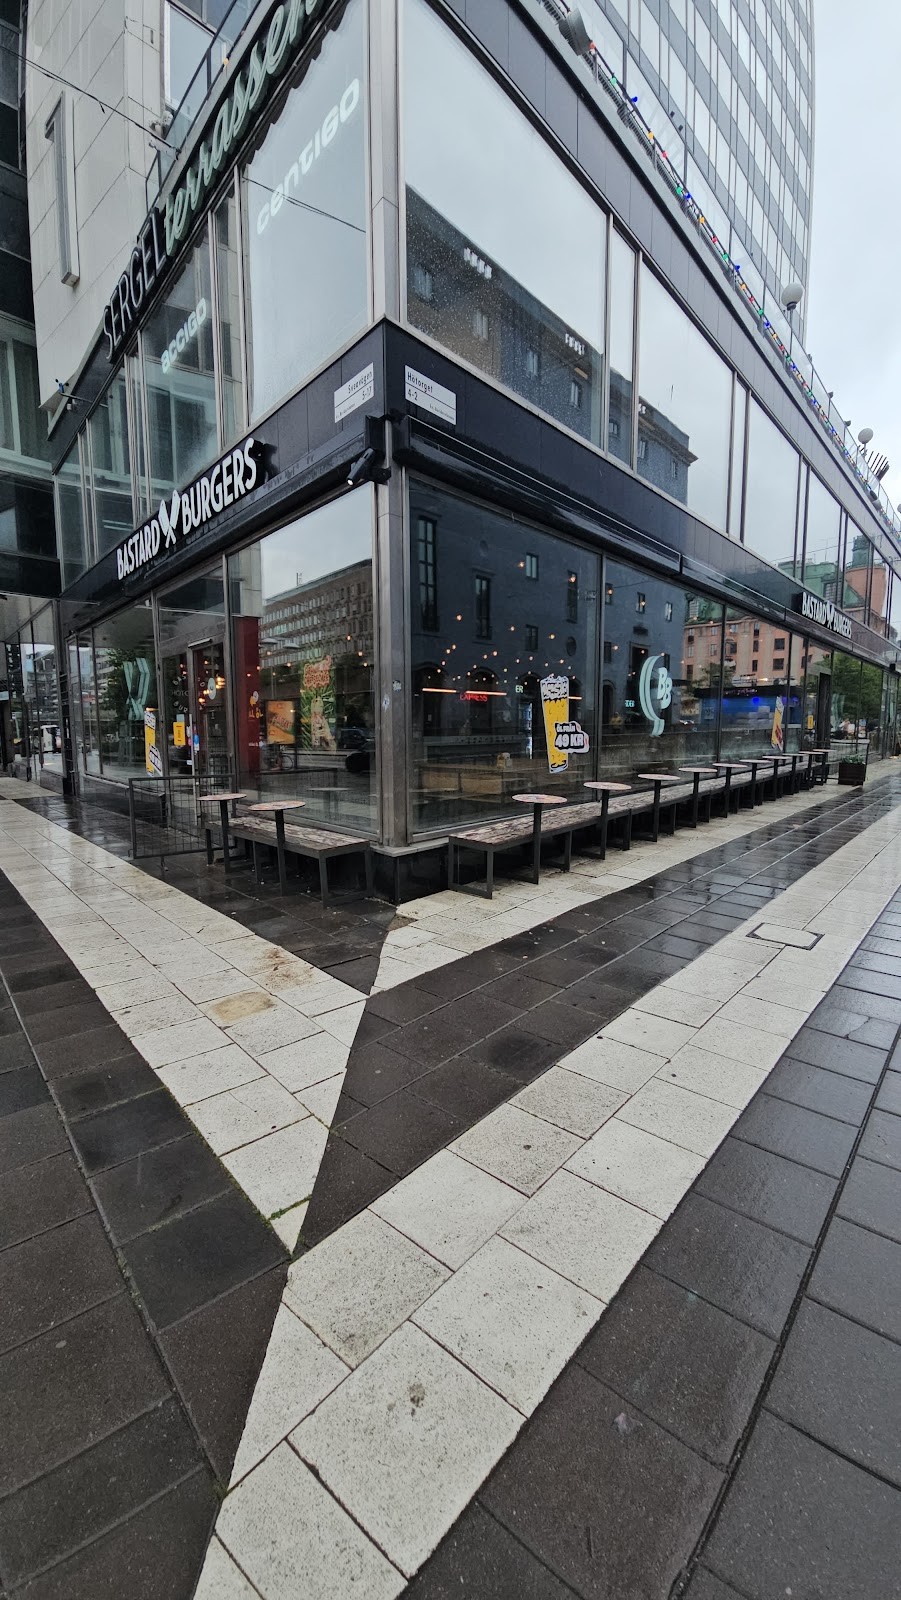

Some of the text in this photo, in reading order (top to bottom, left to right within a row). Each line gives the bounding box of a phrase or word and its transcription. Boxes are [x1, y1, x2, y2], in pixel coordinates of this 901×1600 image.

[103, 210, 167, 360] SERGEL
[407, 371, 433, 393] Hötorget
[407, 388, 418, 401] 4-2
[116, 437, 257, 581] BASTARD BURGERS
[801, 591, 827, 625] BASTARD
[555, 733, 584, 748] 49 KR
